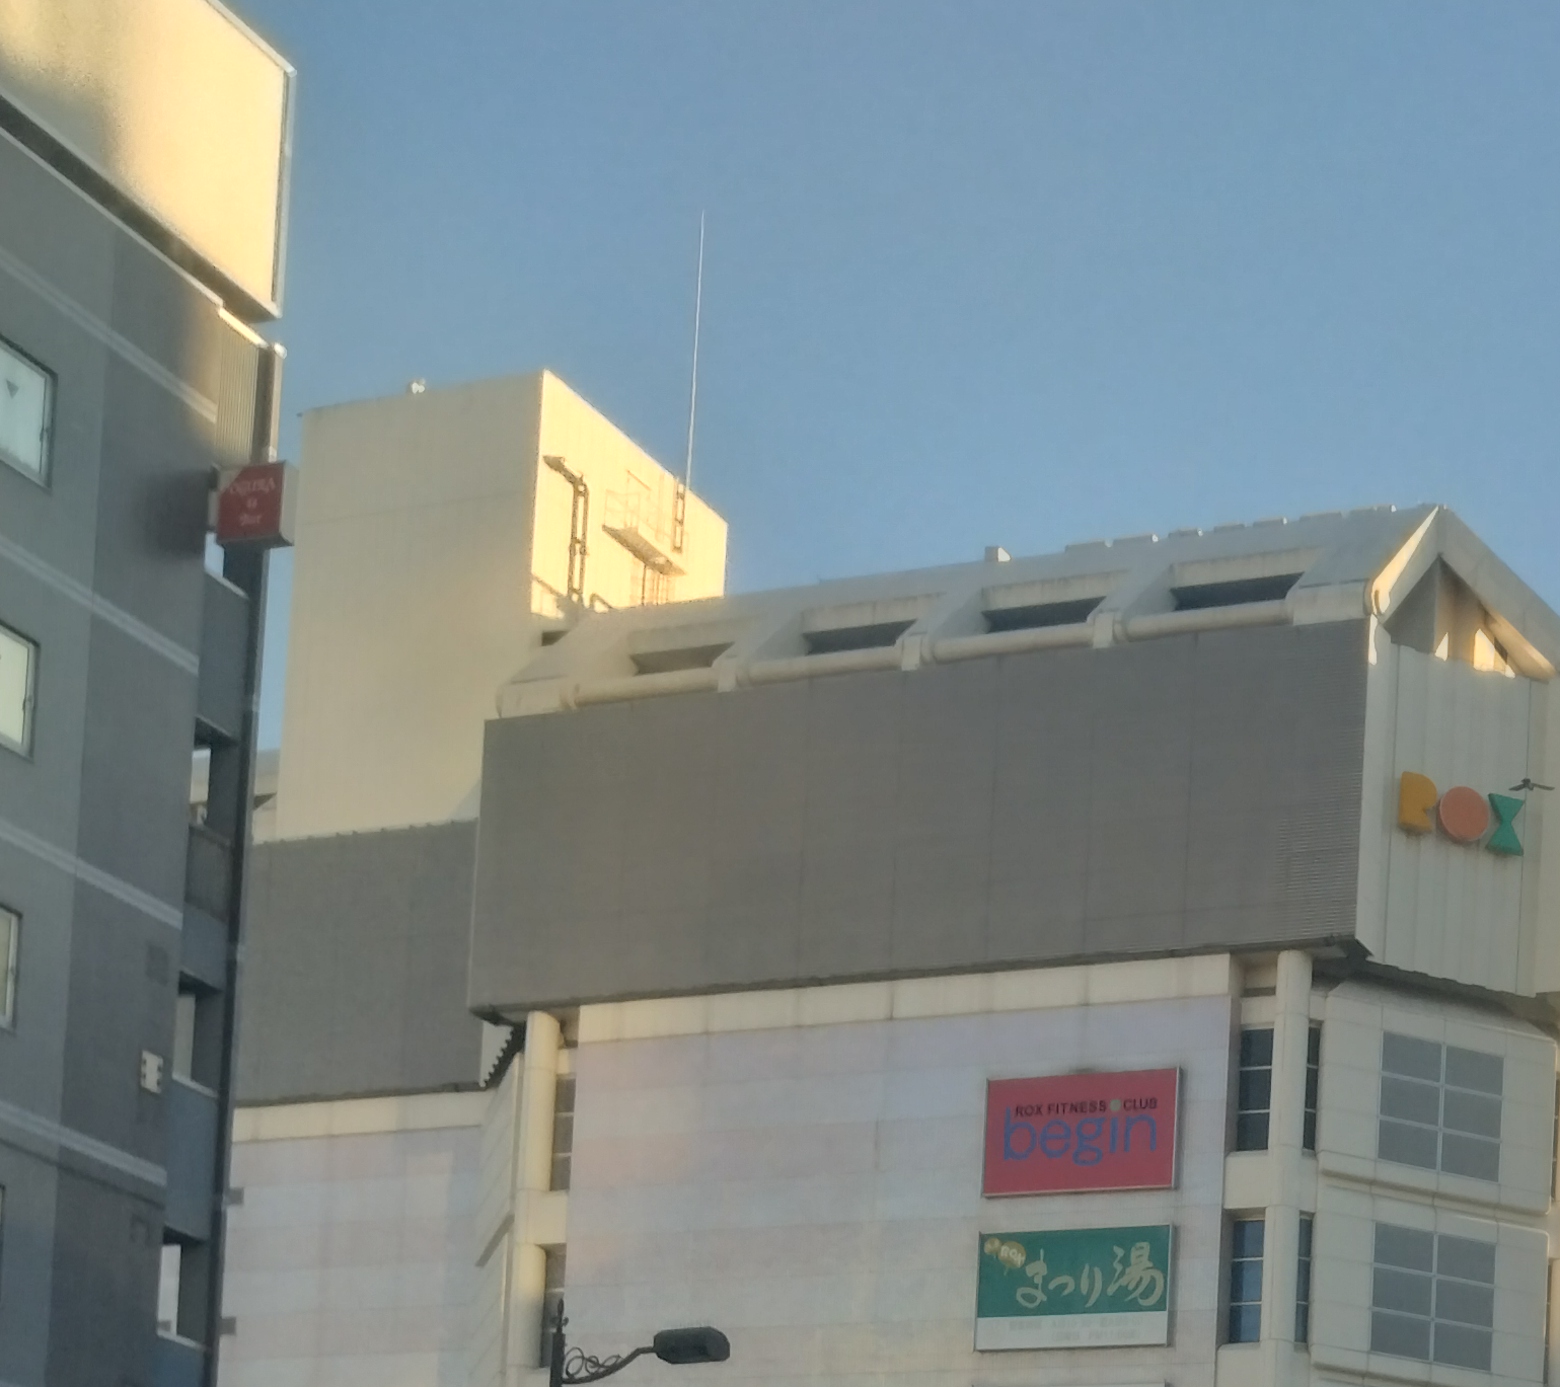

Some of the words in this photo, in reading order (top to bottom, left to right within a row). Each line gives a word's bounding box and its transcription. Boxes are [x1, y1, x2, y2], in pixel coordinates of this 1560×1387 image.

[1003, 1103, 1158, 1168] begin
[1014, 1104, 1044, 1118] ROX
[1048, 1099, 1107, 1116] FITNESS
[1122, 1097, 1158, 1111] CLUB
[1015, 1241, 1165, 1310] まつり湯
